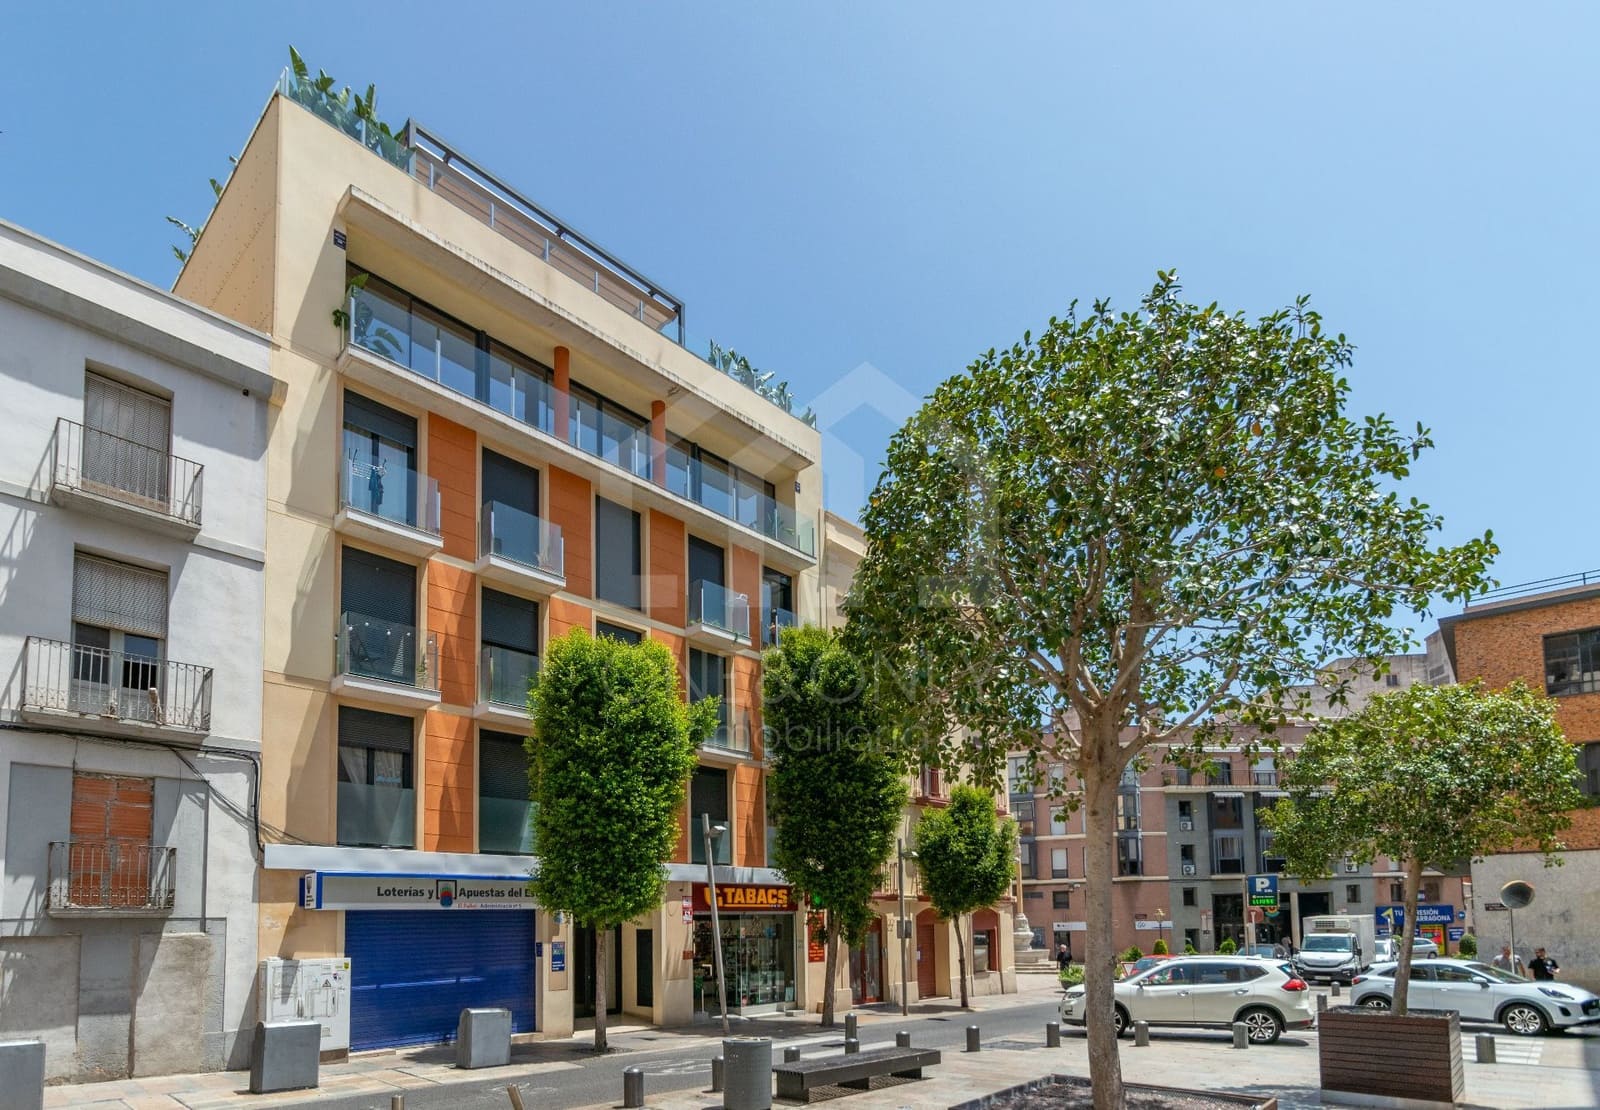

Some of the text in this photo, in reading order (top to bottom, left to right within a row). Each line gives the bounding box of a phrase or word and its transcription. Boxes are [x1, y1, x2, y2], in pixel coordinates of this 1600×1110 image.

[1255, 878, 1270, 892] P
[377, 886, 425, 897] Loterías
[428, 888, 434, 900] y
[459, 888, 505, 900] Apuestas
[508, 887, 522, 898] del
[723, 887, 788, 905] TABACS
